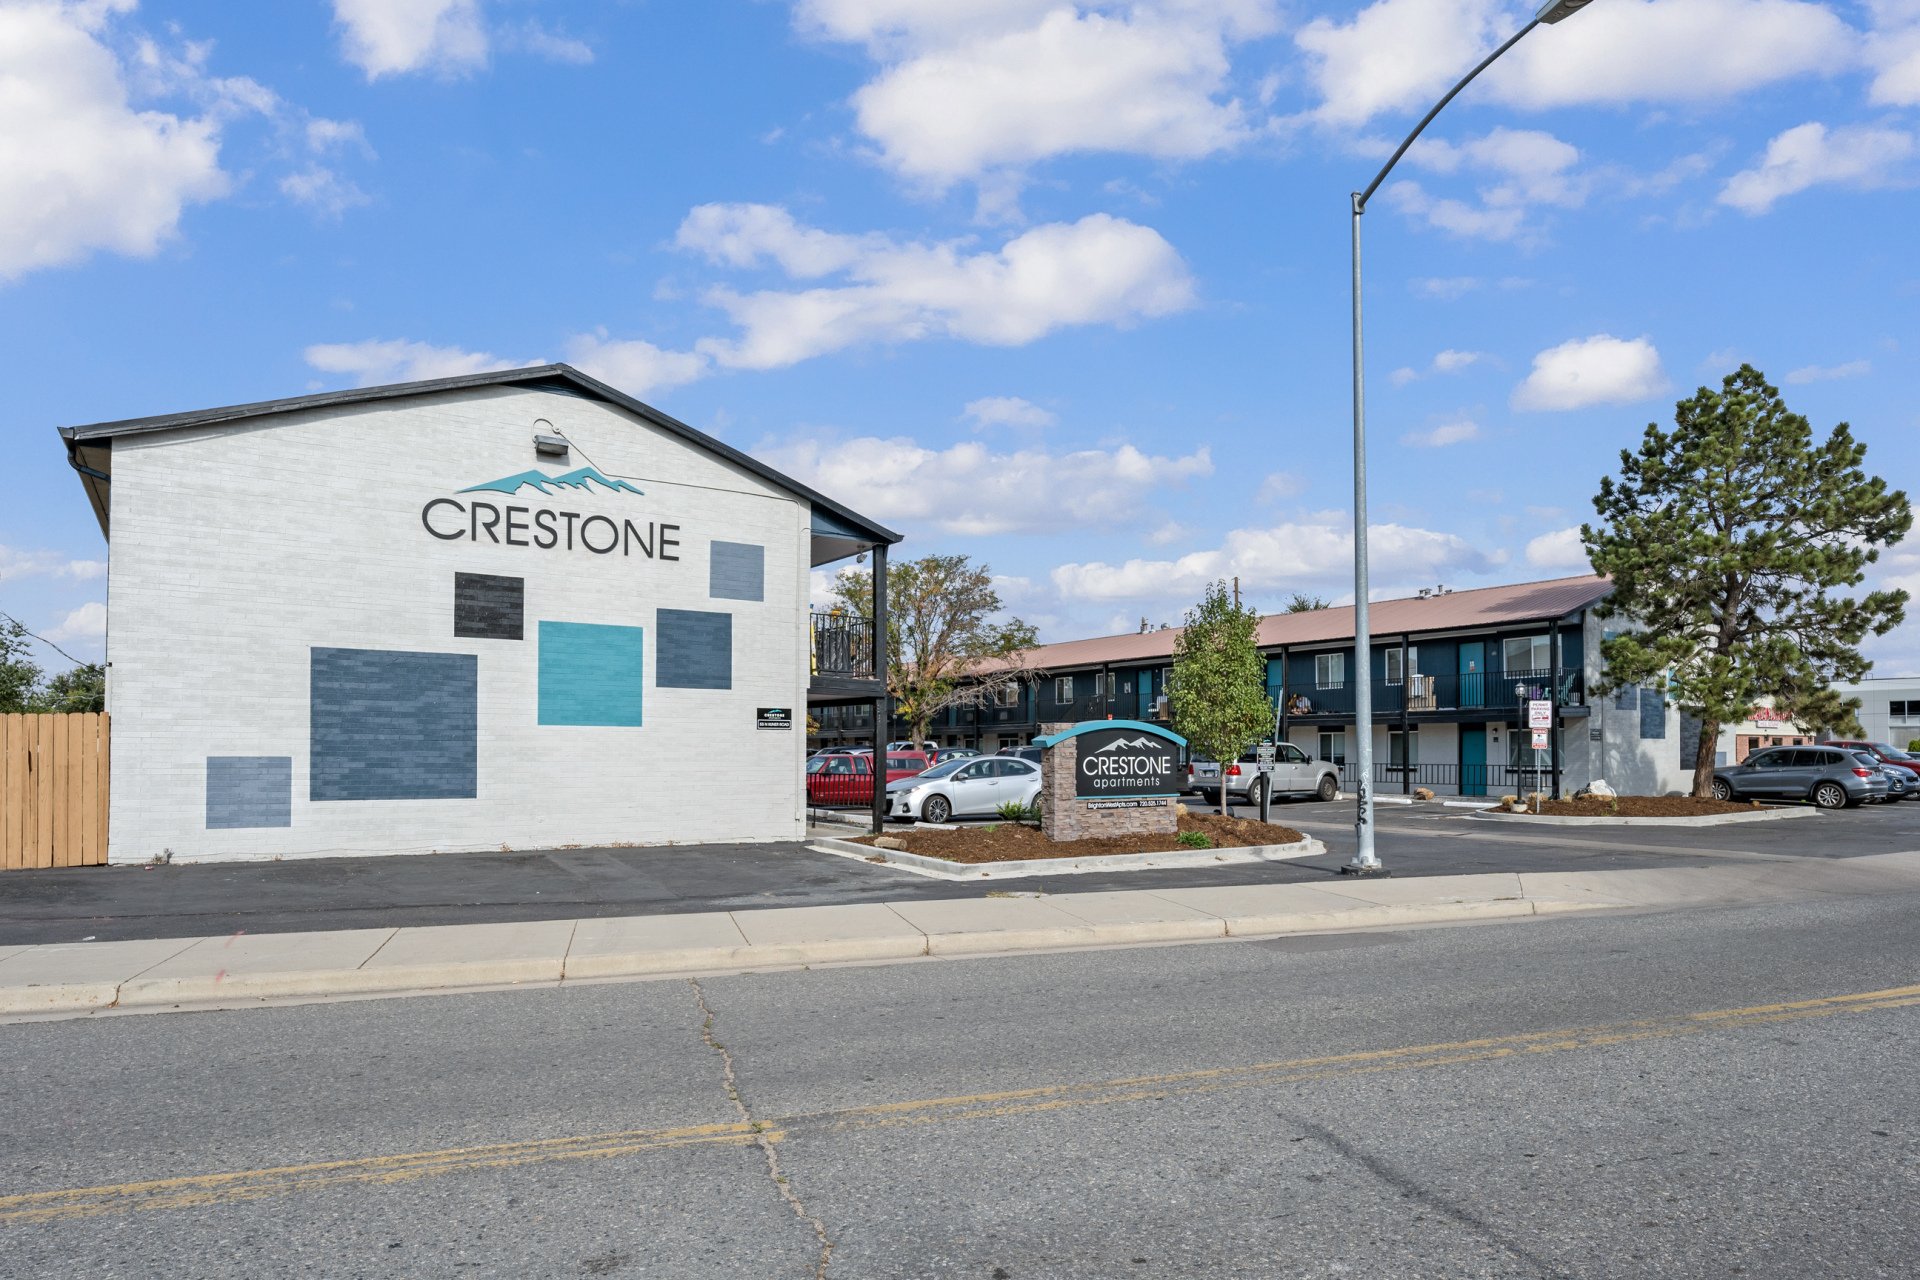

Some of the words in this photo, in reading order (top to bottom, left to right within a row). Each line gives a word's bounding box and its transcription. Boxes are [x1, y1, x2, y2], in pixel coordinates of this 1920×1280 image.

[421, 497, 681, 562] CRESTONE
[1082, 756, 1171, 776] CRESTONE
[1093, 776, 1160, 789] apartments
